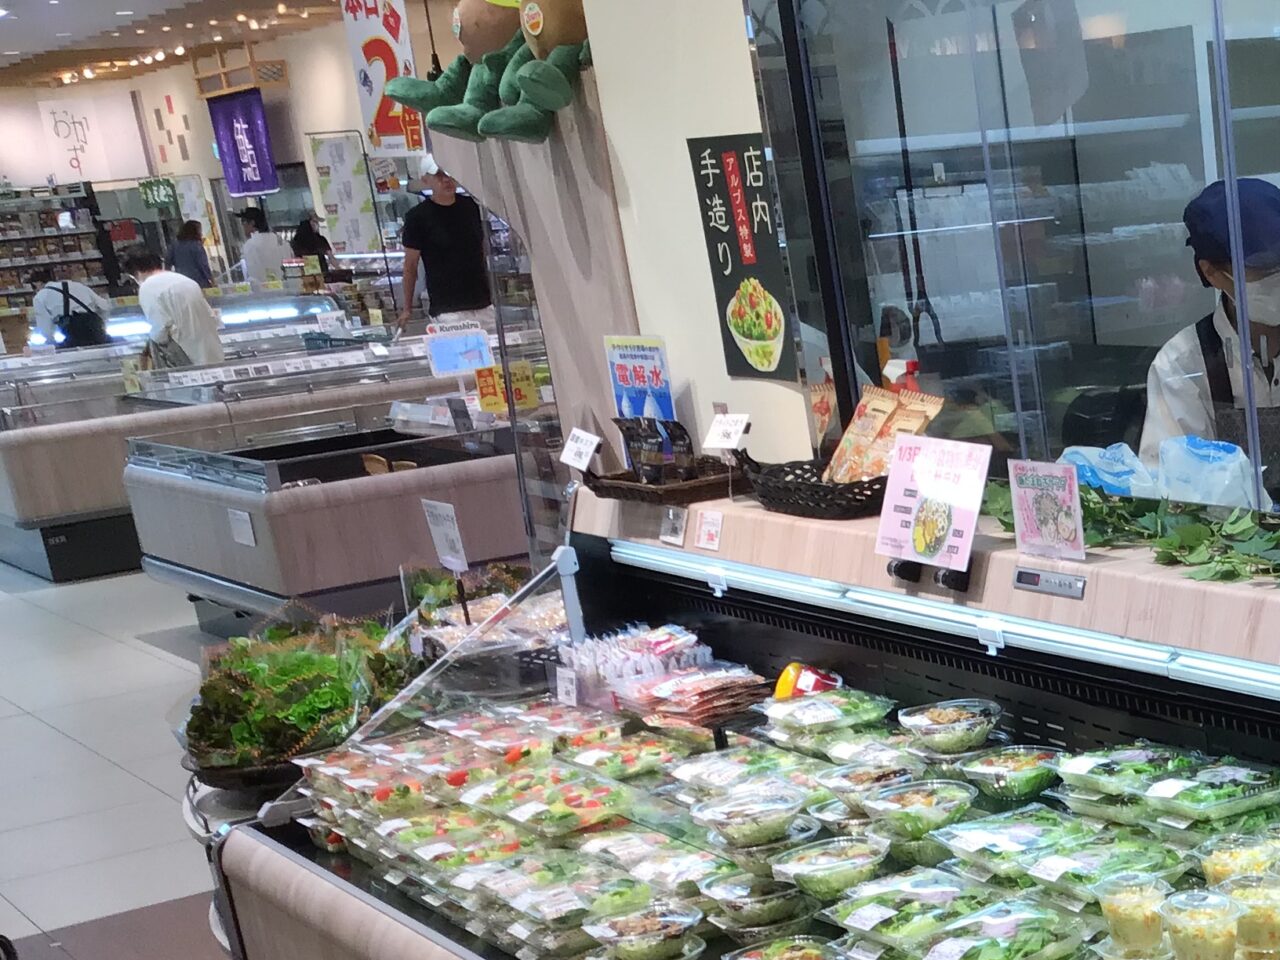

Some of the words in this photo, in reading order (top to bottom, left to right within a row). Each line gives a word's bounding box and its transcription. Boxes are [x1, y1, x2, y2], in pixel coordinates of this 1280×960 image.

[50, 110, 91, 176] おかず
[700, 148, 732, 276] 手造り
[726, 157, 753, 257] アルプス特製
[743, 146, 772, 234] 店内
[615, 363, 665, 389] 電解水
